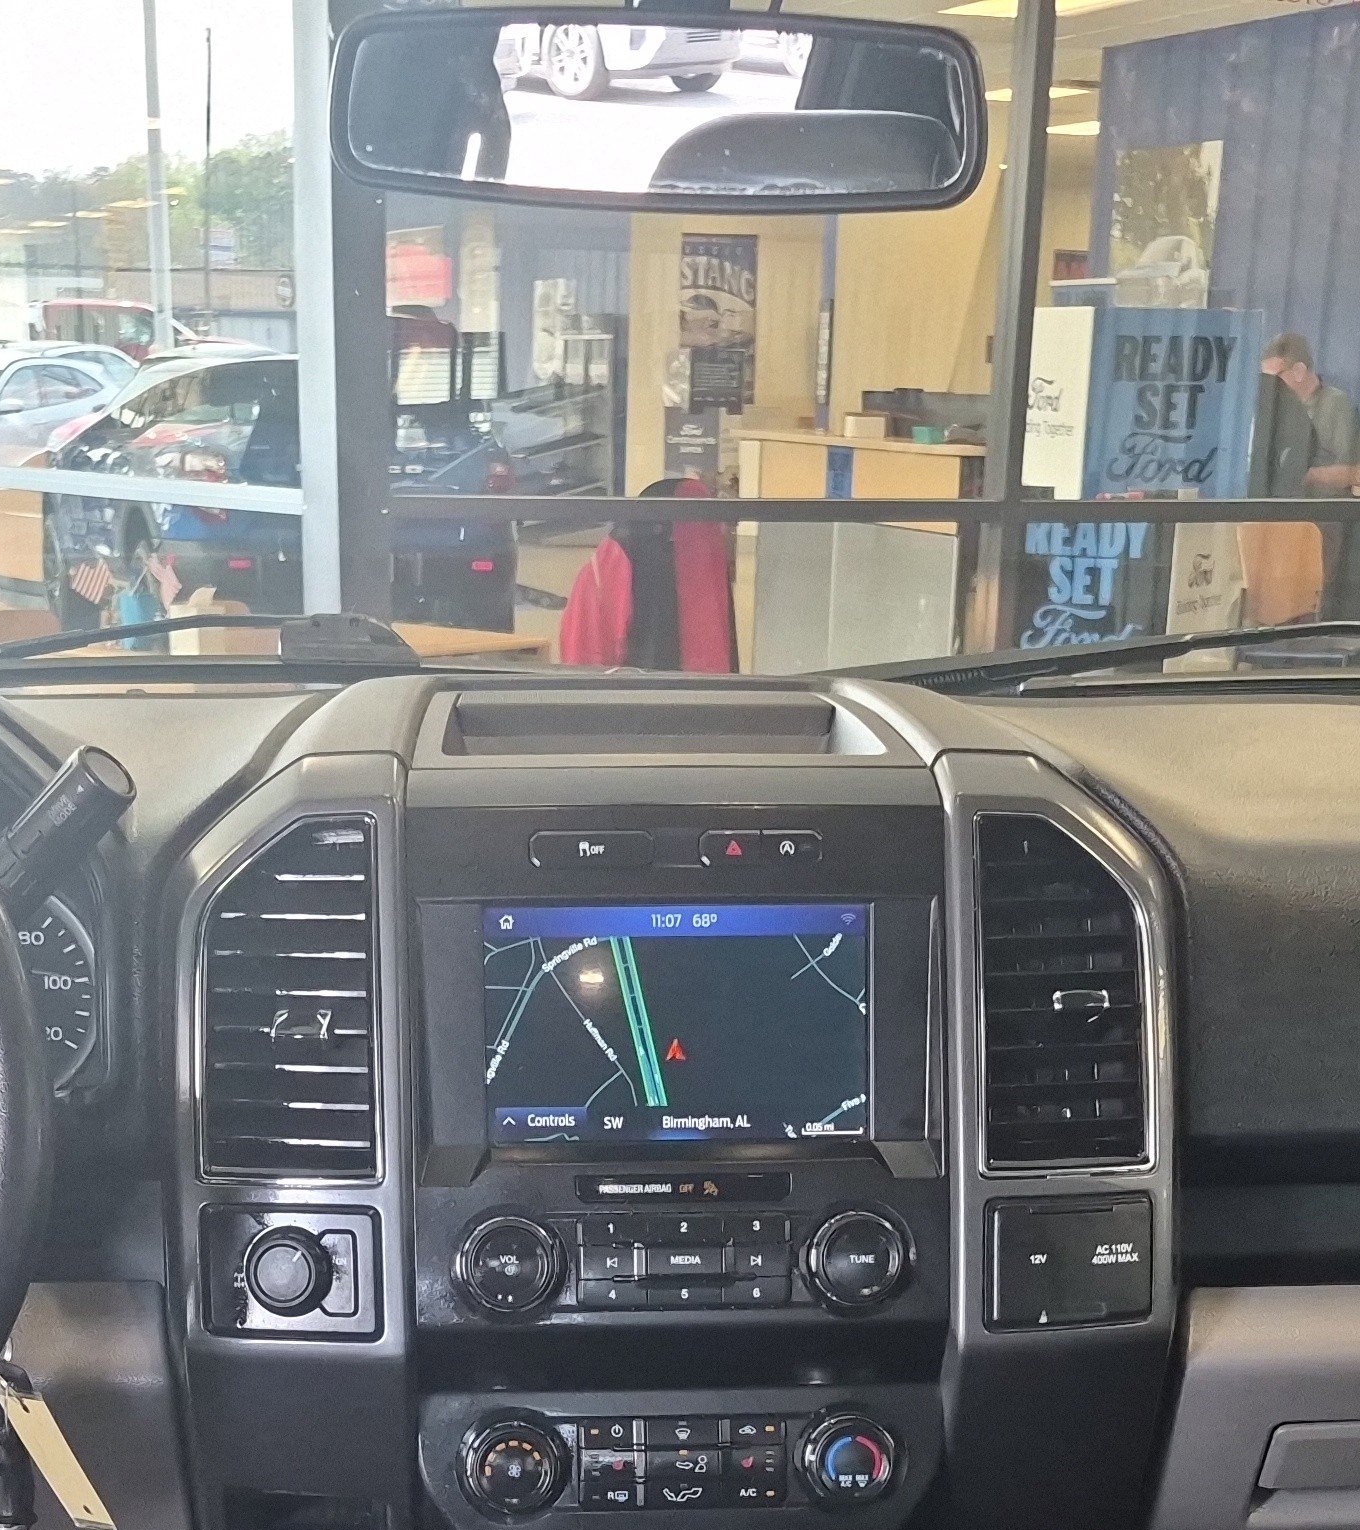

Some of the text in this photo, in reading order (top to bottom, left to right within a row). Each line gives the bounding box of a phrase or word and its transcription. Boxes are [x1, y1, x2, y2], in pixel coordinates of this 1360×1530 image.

[1113, 334, 1239, 384] READY
[1133, 383, 1206, 431] SET
[1105, 431, 1219, 484] Ford
[1048, 556, 1119, 607] SET
[651, 913, 682, 929] 11:07
[541, 935, 599, 973] Springville Rd
[44, 975, 72, 990] 100
[527, 1113, 576, 1128] Controls
[603, 1116, 624, 1130] SW
[662, 1114, 751, 1132] Birmingham, AL
[598, 1184, 644, 1195] PASSENGER
[644, 1183, 672, 1194] AIRBAG
[680, 1222, 688, 1233] 2
[752, 1220, 761, 1231] 3
[1095, 1245, 1110, 1255] AC
[500, 1255, 520, 1264] VOL
[670, 1255, 702, 1265] MEDIA
[849, 1255, 875, 1264] TUNE
[1030, 1254, 1048, 1265] 12V
[1091, 1252, 1139, 1266] 400W MAX
[608, 1289, 617, 1300] 4
[680, 1288, 689, 1299] 5
[752, 1287, 761, 1298] 6
[740, 1488, 757, 1497] A/C
